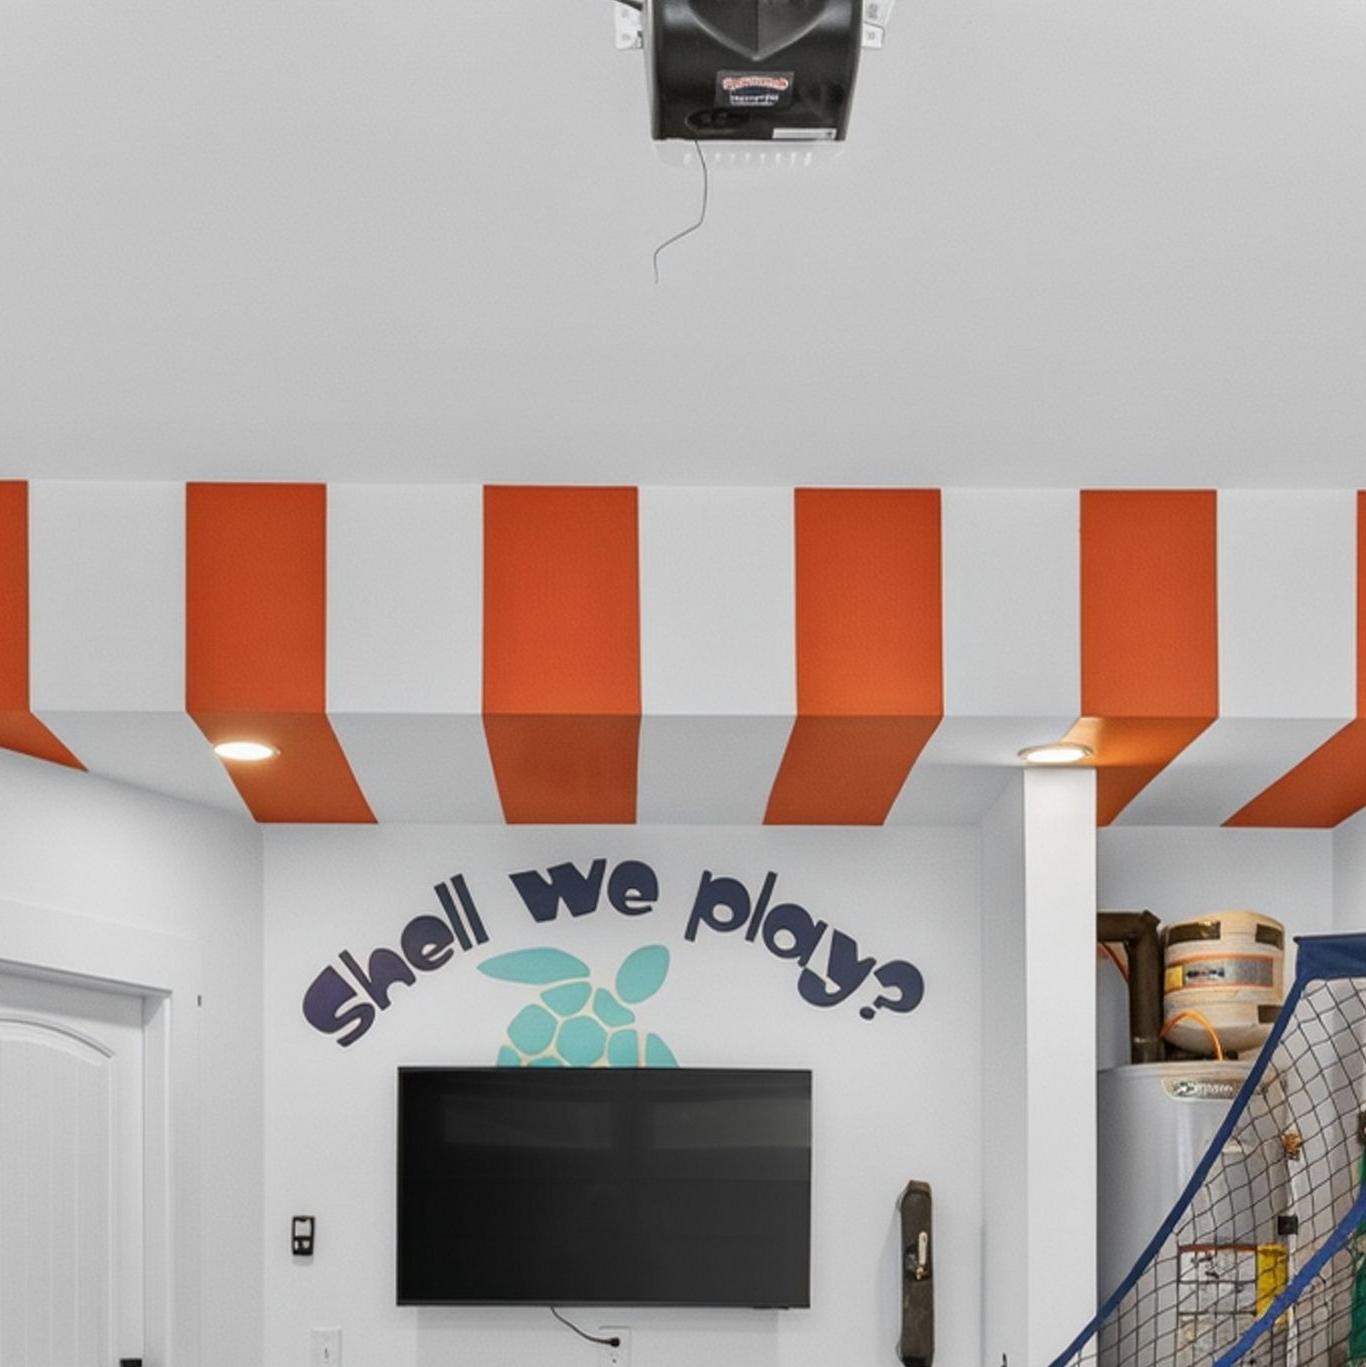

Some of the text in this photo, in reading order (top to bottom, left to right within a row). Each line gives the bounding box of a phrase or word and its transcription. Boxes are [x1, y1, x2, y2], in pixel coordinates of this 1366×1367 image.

[302, 858, 925, 1048] Shell we play?
